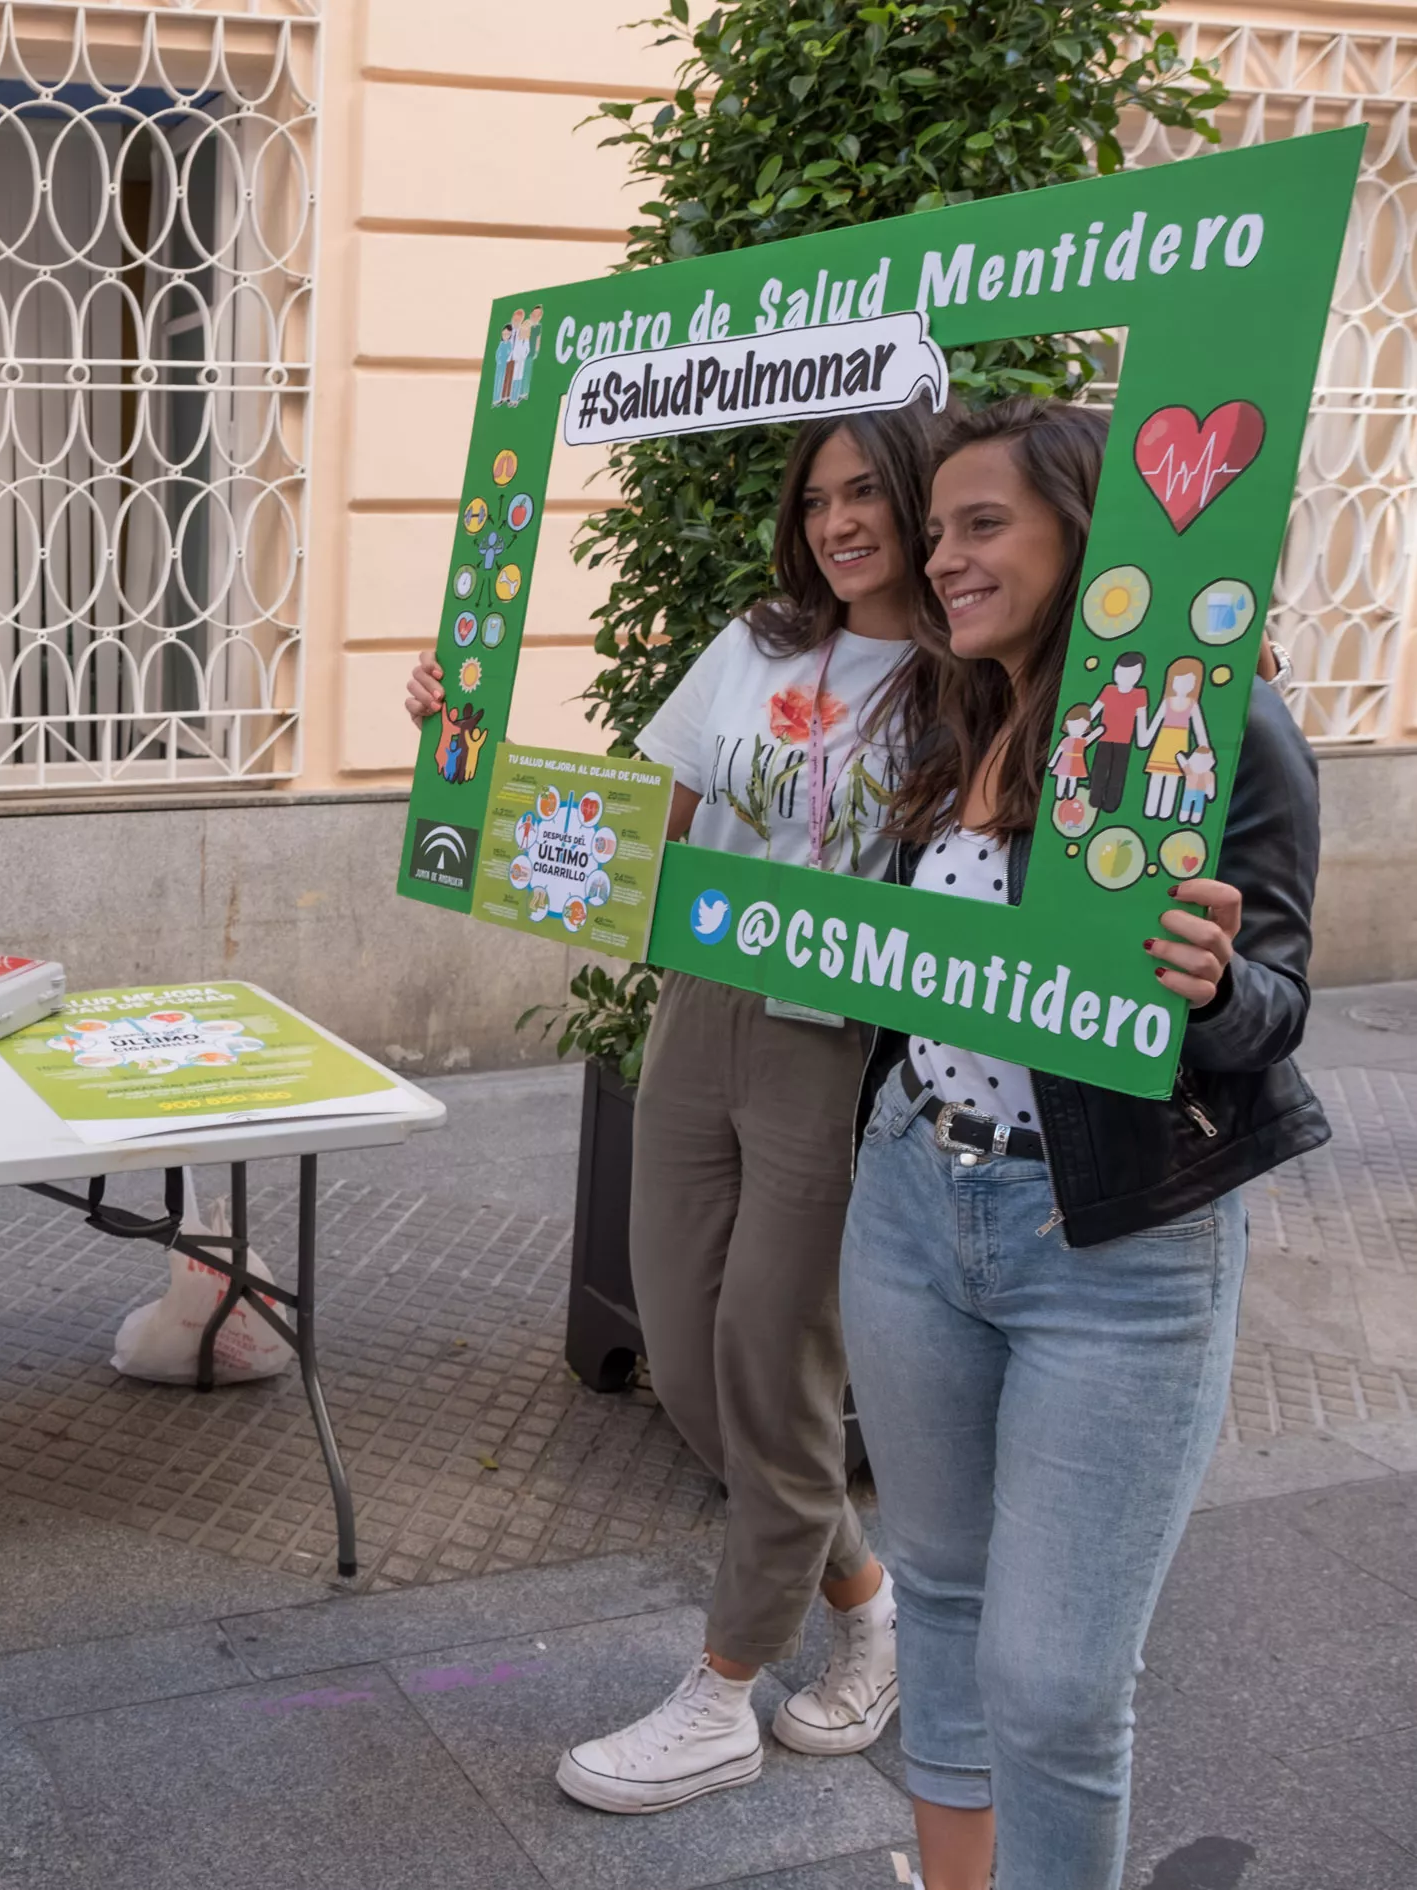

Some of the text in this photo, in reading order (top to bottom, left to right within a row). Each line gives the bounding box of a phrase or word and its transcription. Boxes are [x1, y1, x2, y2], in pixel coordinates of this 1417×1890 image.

[555, 211, 1264, 364] Centro de Salud Mentidero
[579, 342, 897, 429] #SaludPulmonar
[508, 754, 661, 786] TU SALUD MEJORA AL DEJAR DE FUMAR
[542, 830, 586, 846] DESPUÉS DEL
[538, 840, 589, 868] ÚLTIMO
[533, 862, 586, 882] CIGARRILLO
[737, 900, 1171, 1058] @CSMentidero
[116, 1001, 151, 1011] DE
[153, 992, 238, 1006] FUMAR
[122, 987, 223, 1003] MEJORA
[110, 1032, 200, 1048] ÚLTIMO
[113, 1039, 207, 1053] CIGARRILLO
